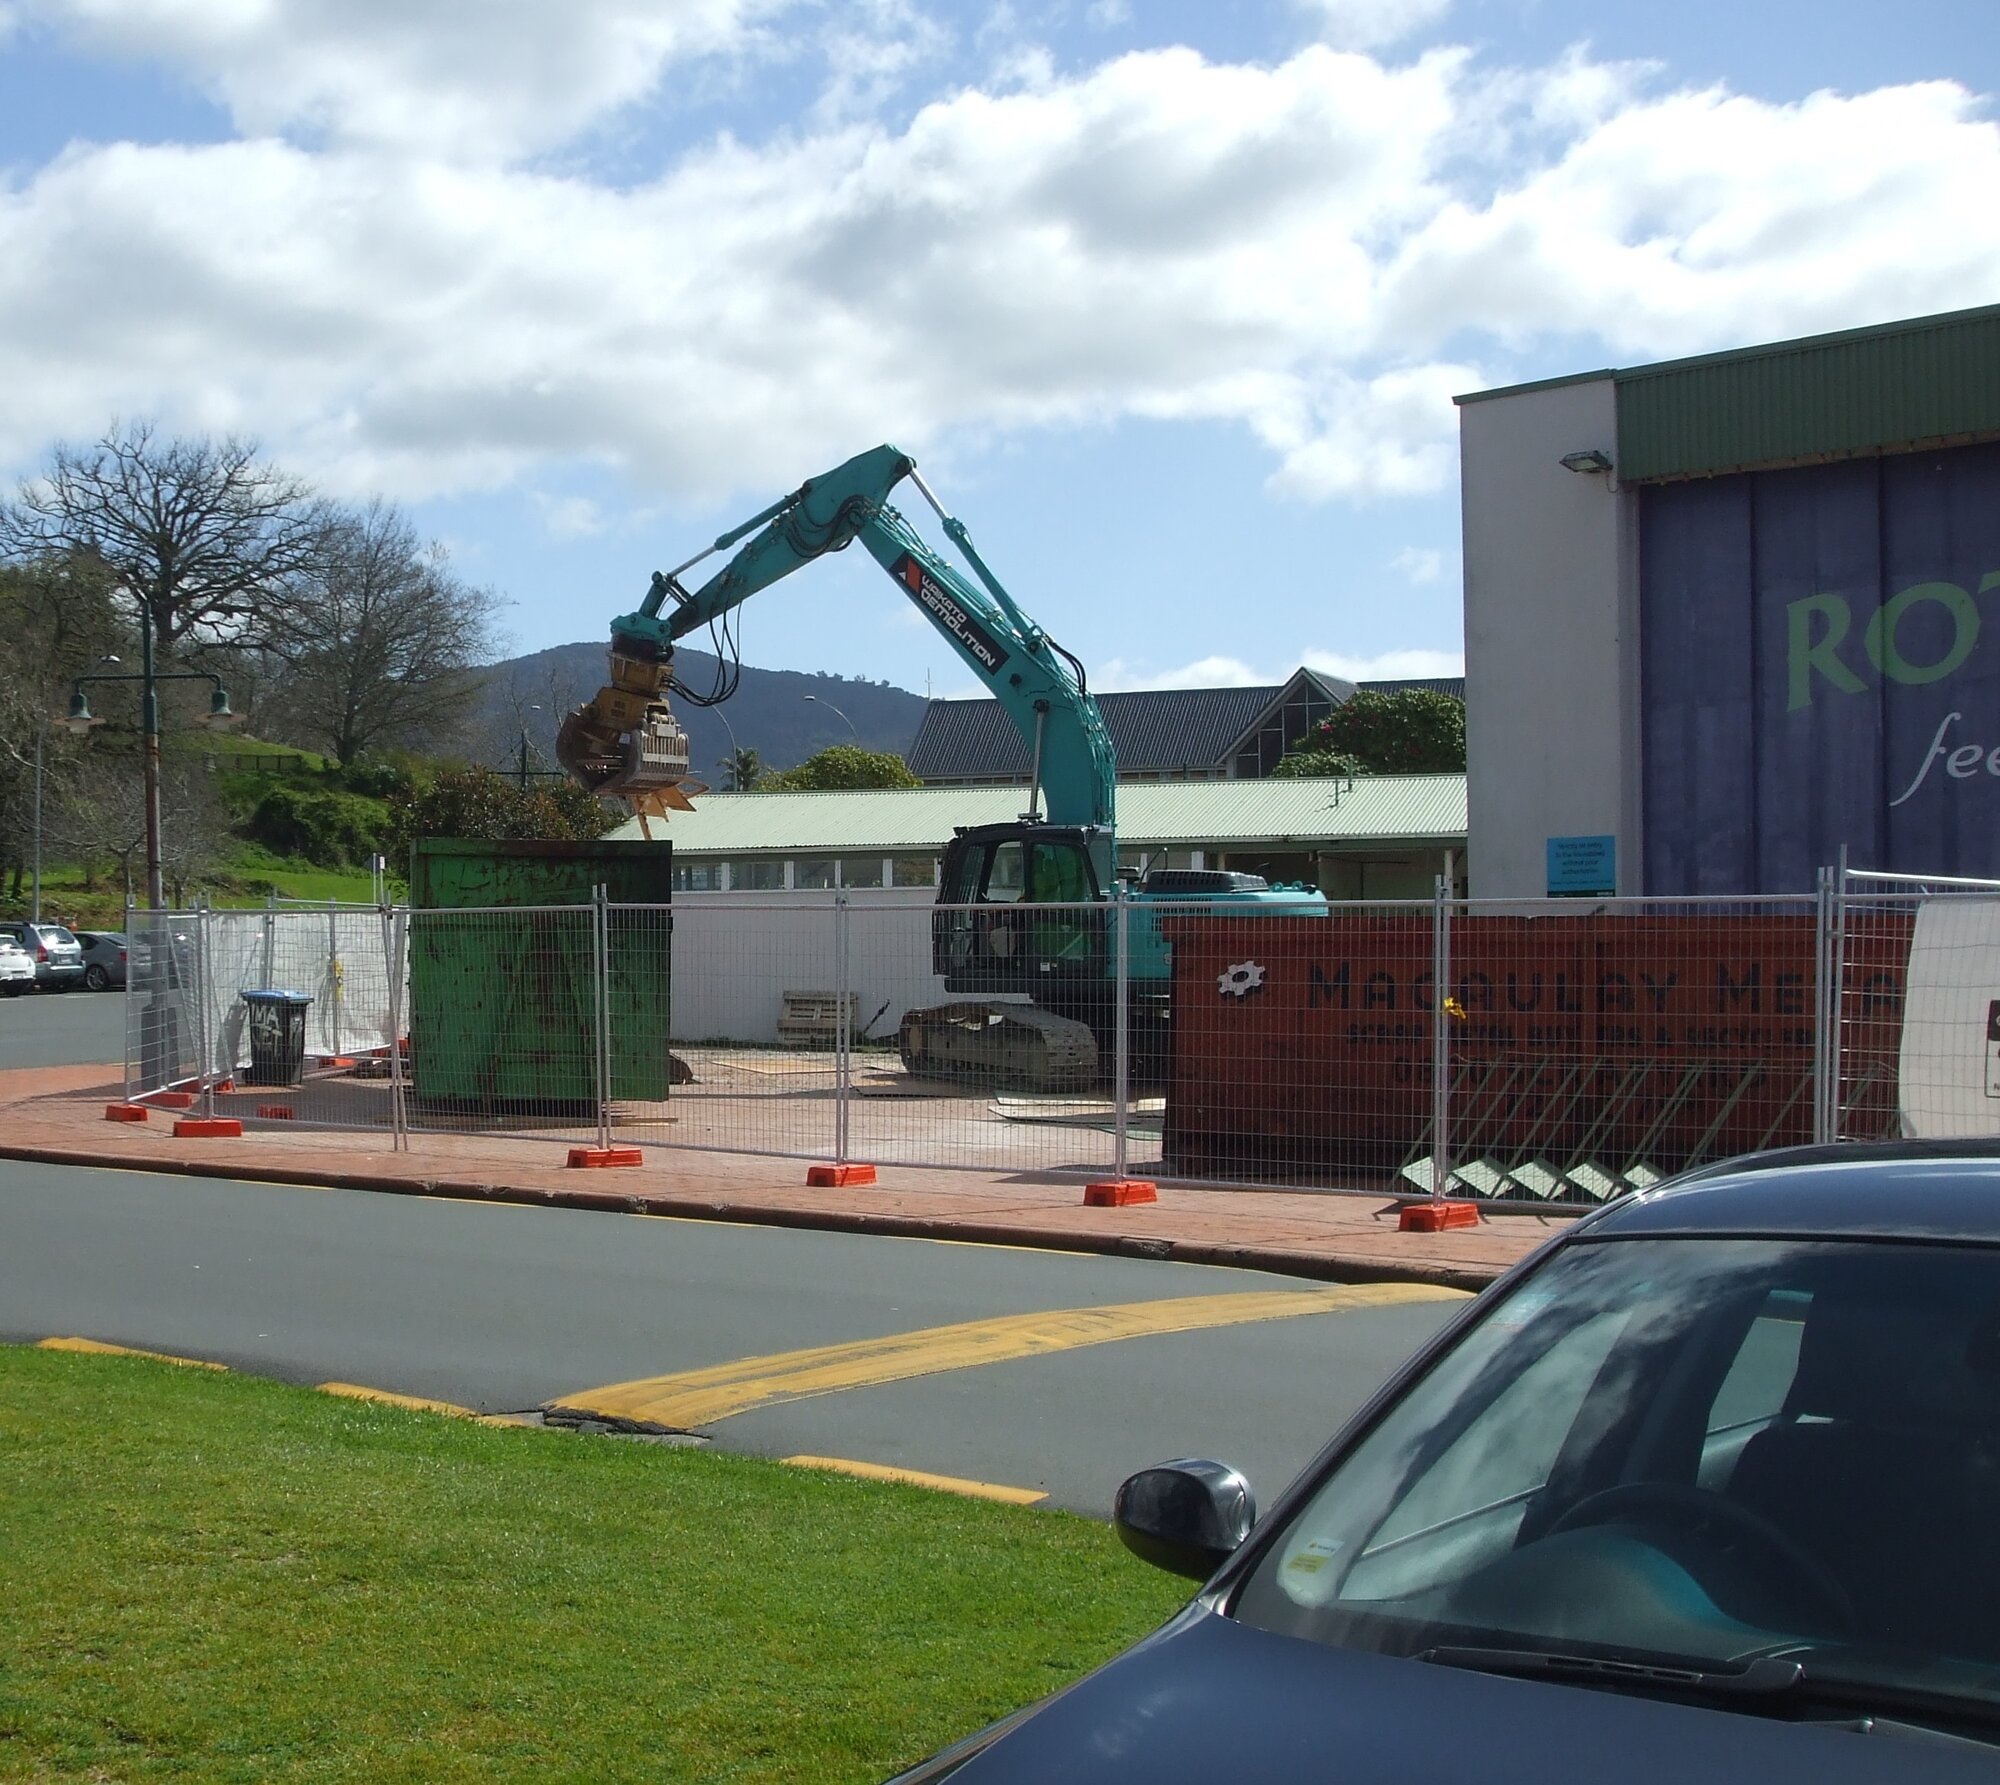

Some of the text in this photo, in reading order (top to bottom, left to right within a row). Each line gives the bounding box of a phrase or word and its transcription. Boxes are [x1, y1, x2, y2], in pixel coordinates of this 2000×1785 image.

[920, 588, 996, 667] DEMOLITION
[921, 575, 967, 623] WAIKATO
[1786, 571, 2000, 713] RO
